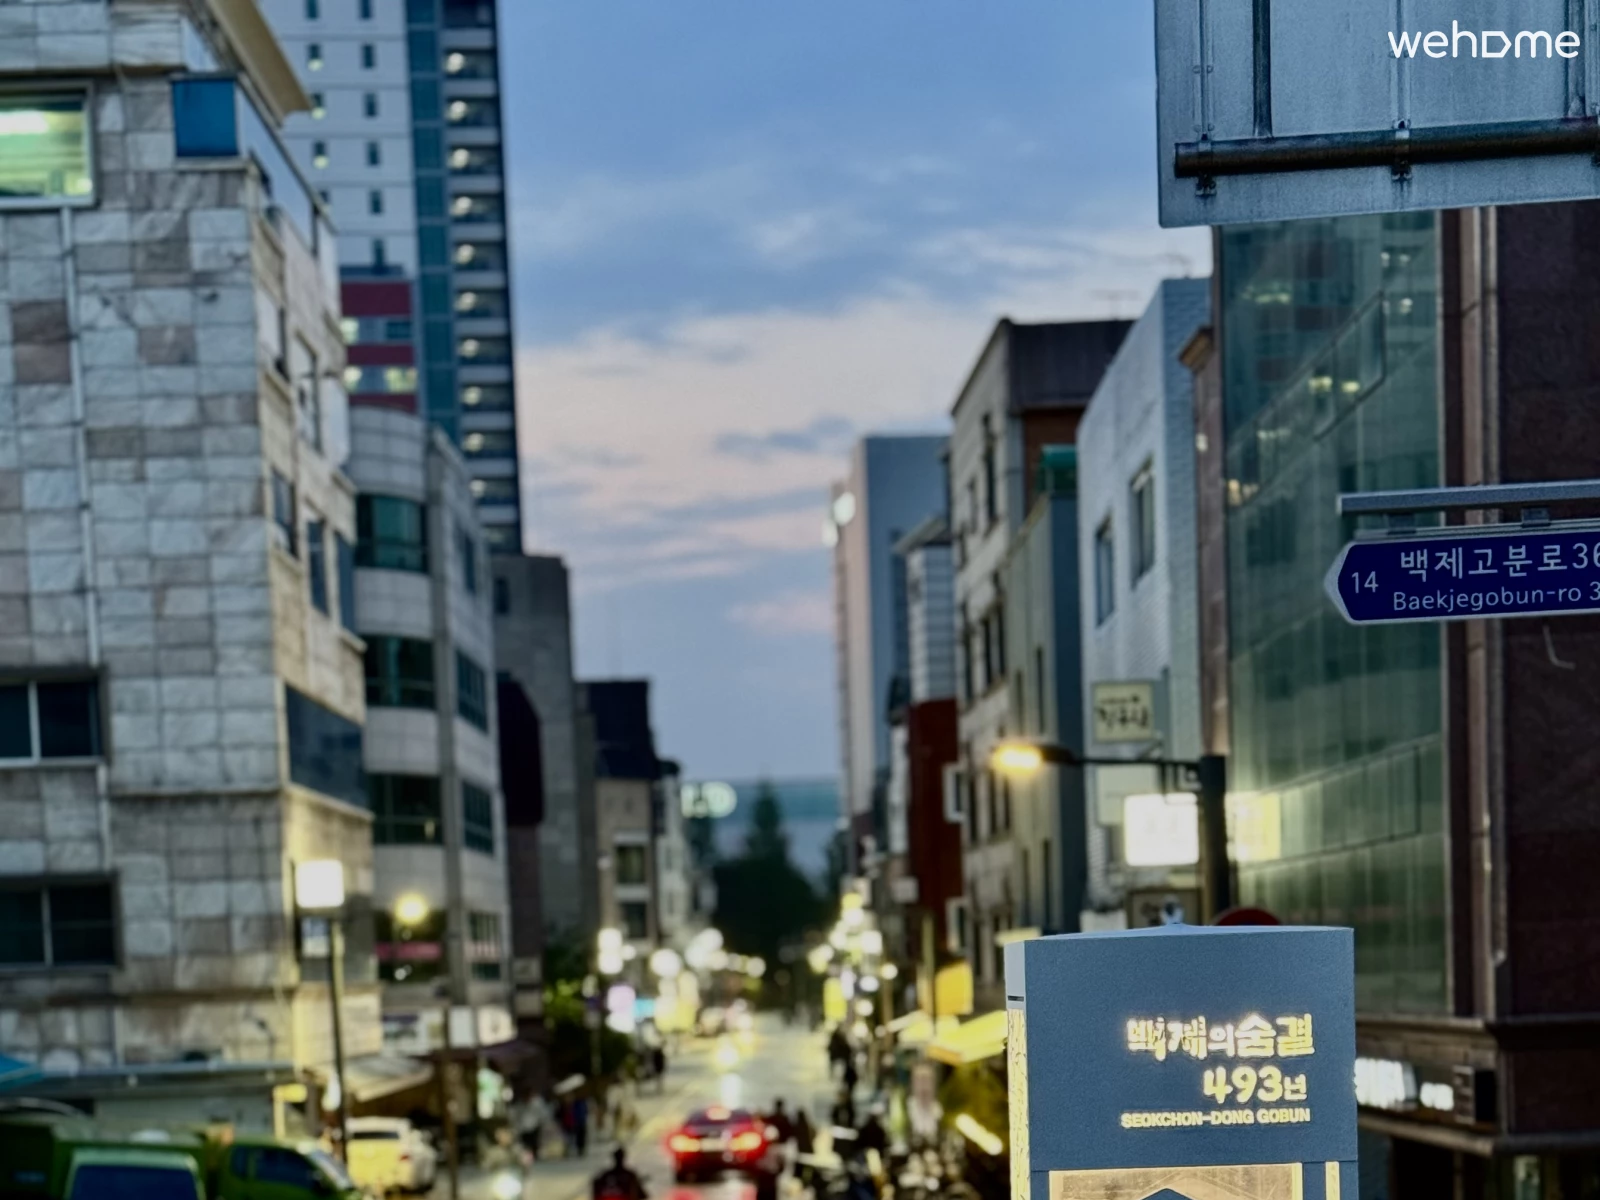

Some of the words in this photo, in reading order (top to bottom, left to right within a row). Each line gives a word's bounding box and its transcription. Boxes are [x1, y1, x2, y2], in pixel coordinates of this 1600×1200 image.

[1351, 570, 1379, 594] 14
[1393, 586, 1582, 613] Baekjegobun-ro
[1203, 1065, 1308, 1104] 493년
[1120, 1109, 1254, 1129] SEOKCHON-DONG
[1256, 1107, 1311, 1124] GOBUN
